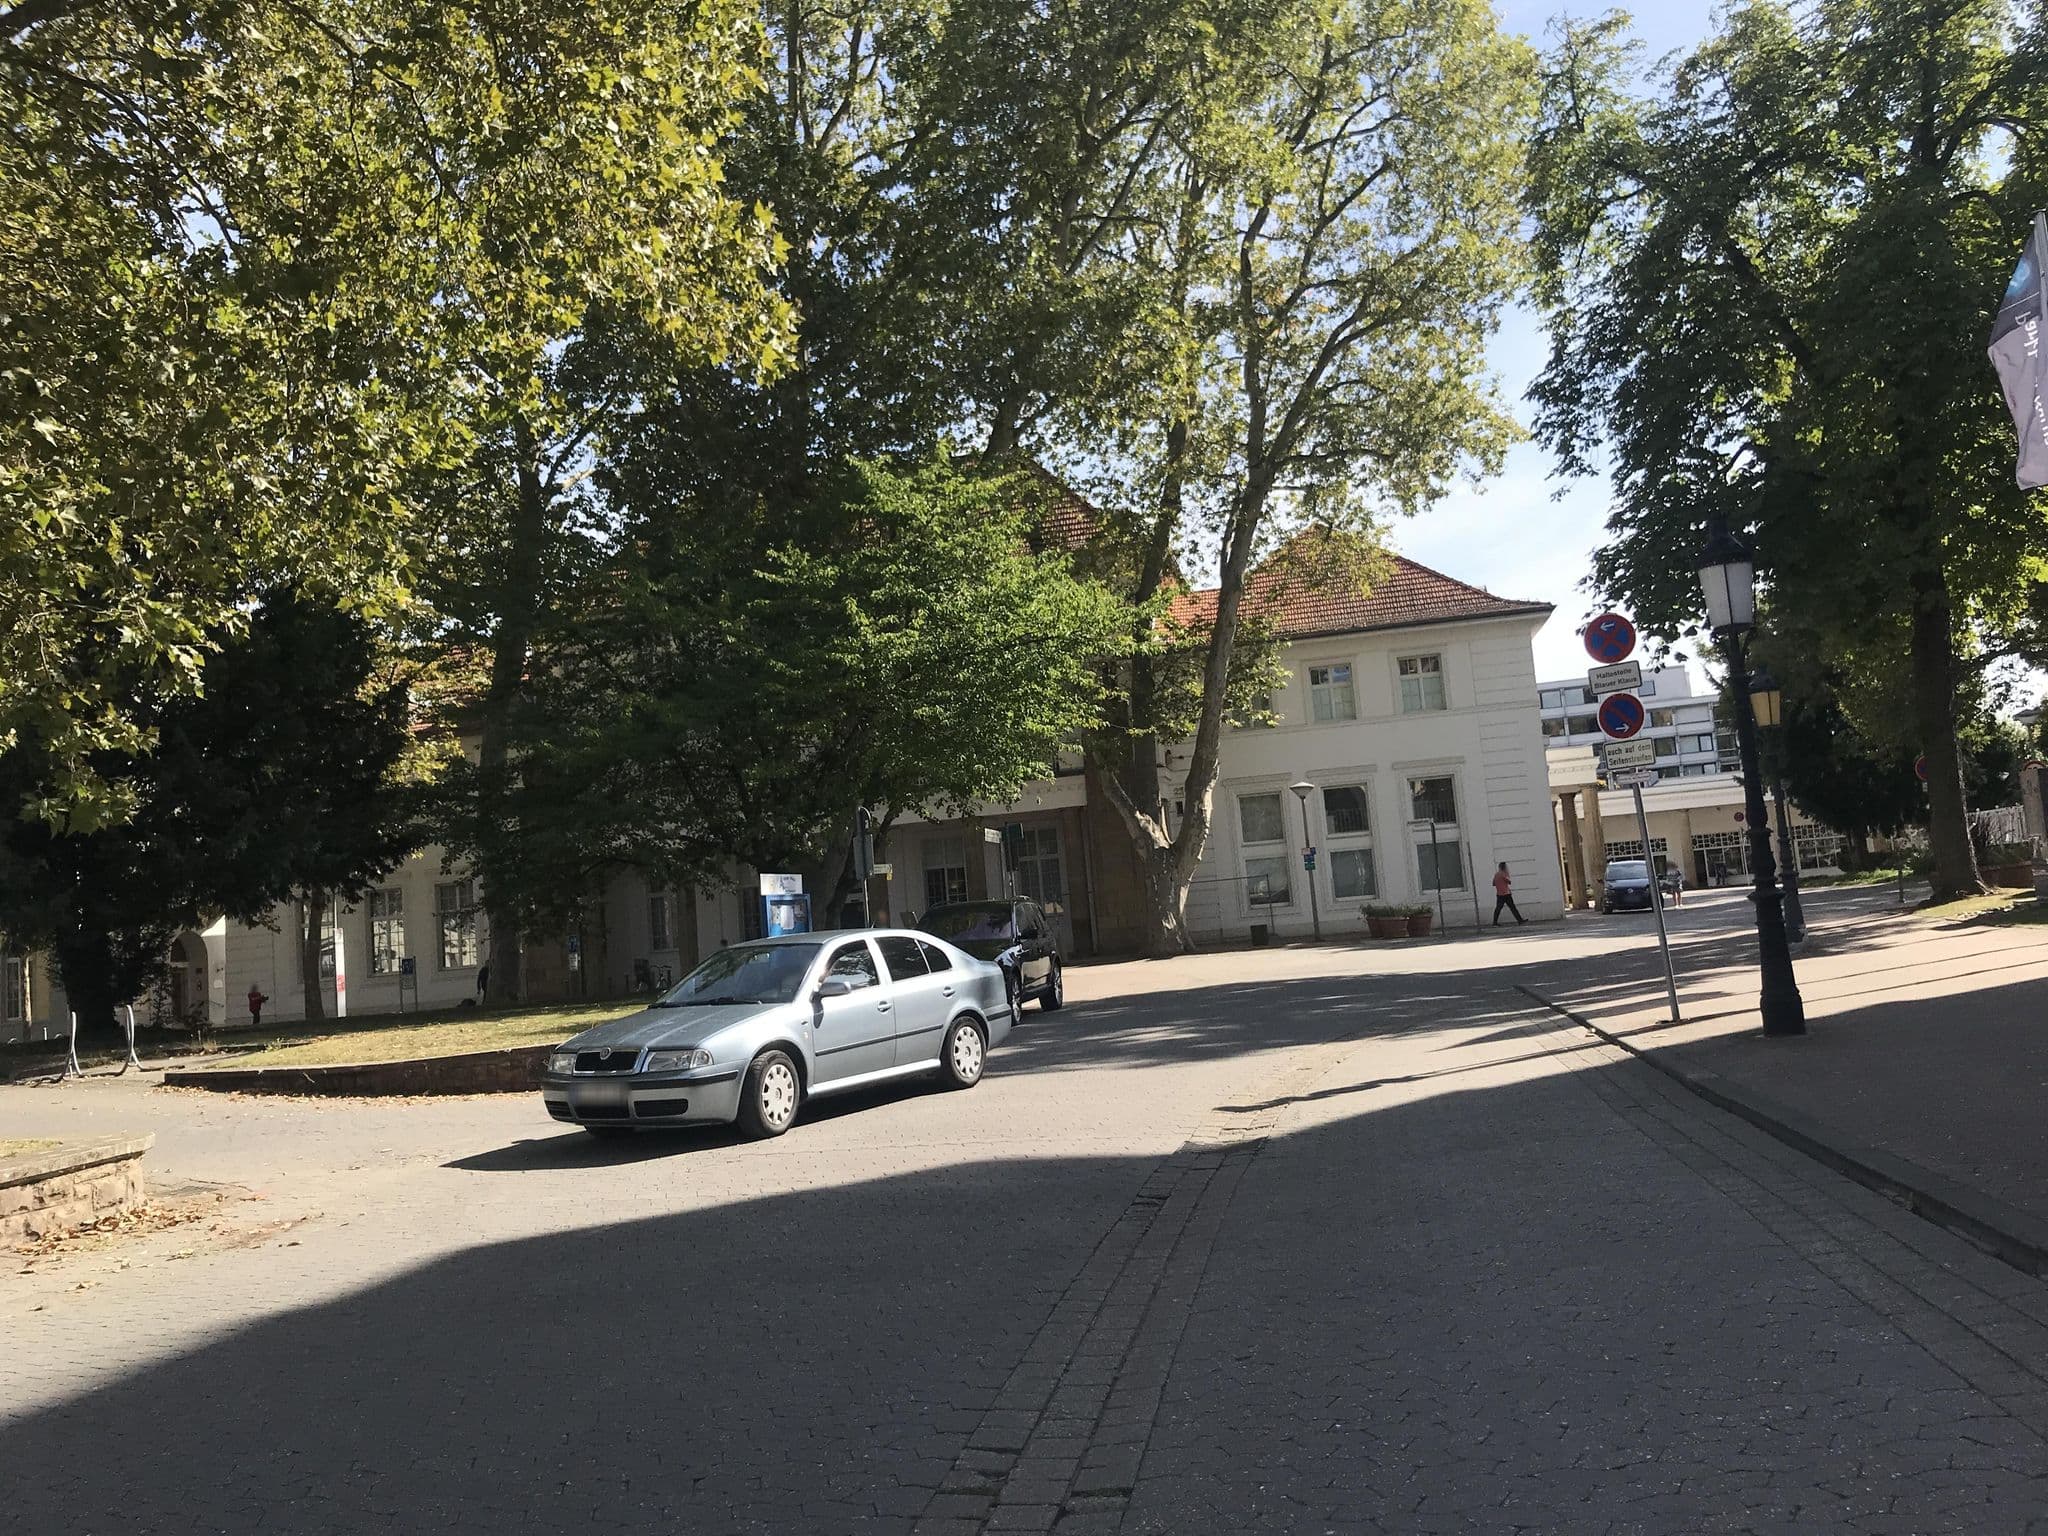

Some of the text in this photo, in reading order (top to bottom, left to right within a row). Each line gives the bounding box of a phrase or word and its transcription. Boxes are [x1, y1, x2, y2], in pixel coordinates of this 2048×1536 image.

[1607, 742, 1652, 756] auch auf dem
[1608, 753, 1653, 766] Seitenstreifen
